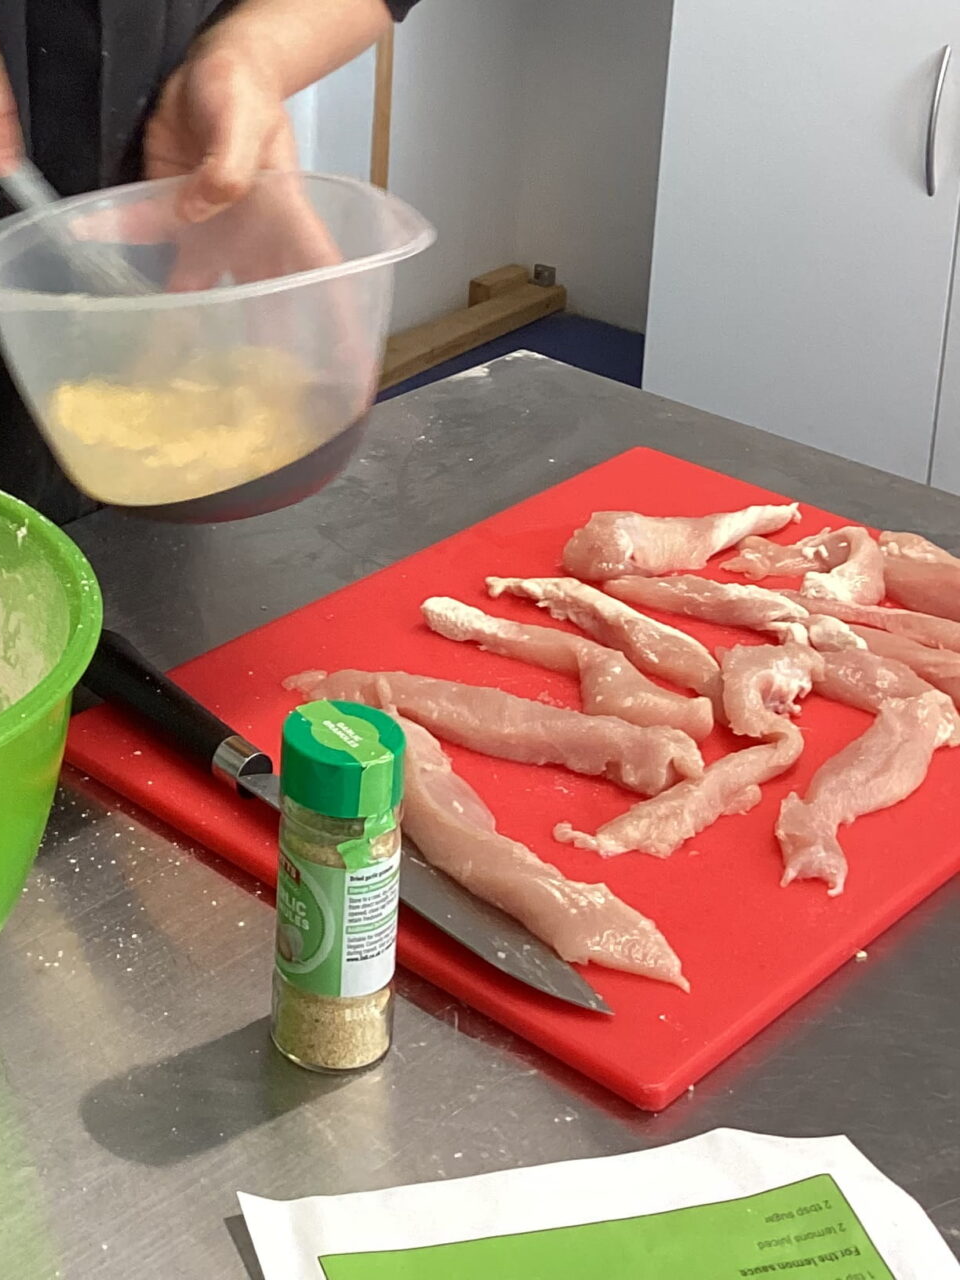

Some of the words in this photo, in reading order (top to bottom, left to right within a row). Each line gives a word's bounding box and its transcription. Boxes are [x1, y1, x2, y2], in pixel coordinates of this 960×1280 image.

[796, 1201, 823, 1217] tbsp
[823, 1199, 832, 1210] 2
[765, 1211, 795, 1223] sugar
[794, 1225, 837, 1243] lemons
[838, 1222, 847, 1233] 2
[757, 1236, 792, 1250] juiced
[818, 1250, 840, 1263] the
[842, 1245, 862, 1258] For
[777, 1257, 819, 1270] lemon
[739, 1264, 777, 1277] sauce
